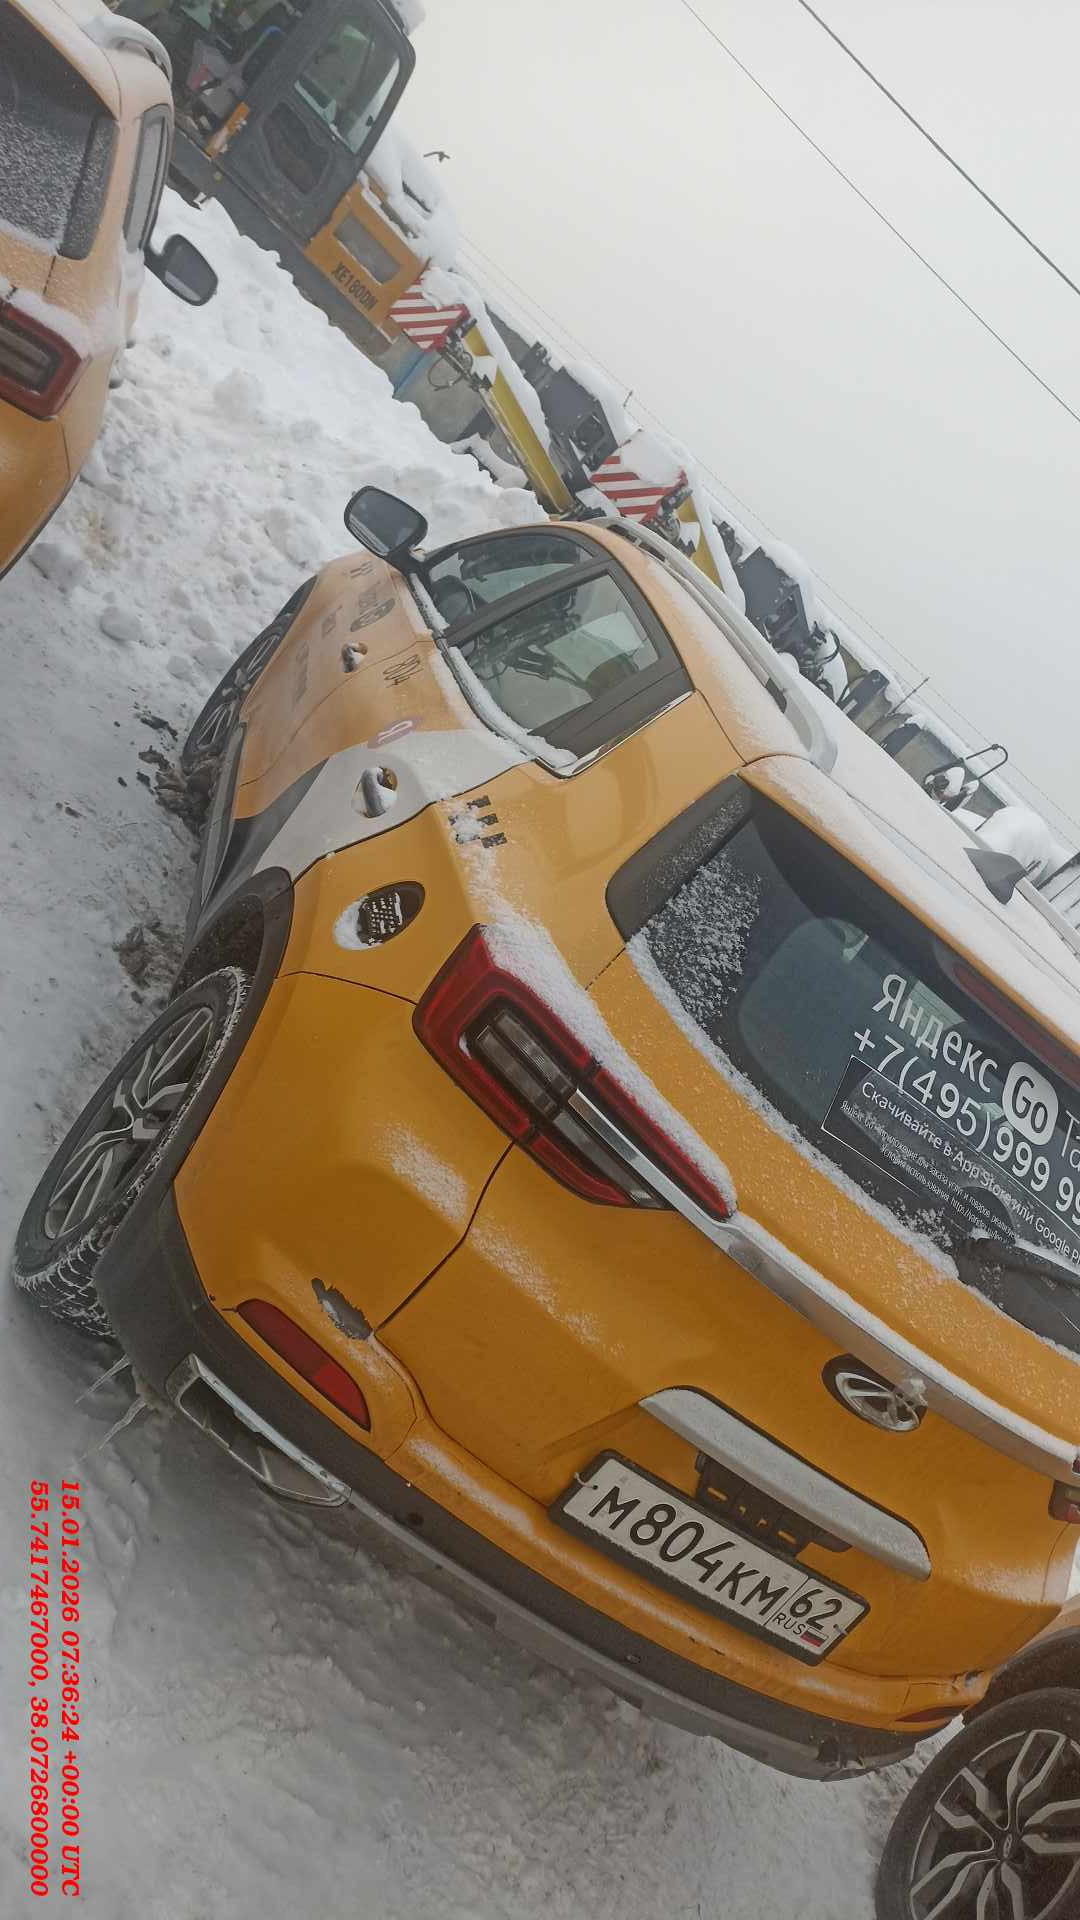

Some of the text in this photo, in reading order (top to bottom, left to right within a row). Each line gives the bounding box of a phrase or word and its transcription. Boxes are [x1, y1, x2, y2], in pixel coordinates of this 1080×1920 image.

[872, 974, 999, 1092] Яндекс
[1012, 1075, 1048, 1133] Go
[862, 1081, 943, 1149] Скачивайте
[943, 1144, 952, 1157] в
[953, 1150, 980, 1179] App
[1012, 1200, 1034, 1225] или
[1036, 1217, 1070, 1257] Google
[588, 1486, 843, 1631] М804КМ 62
[774, 1612, 804, 1635] RUS
